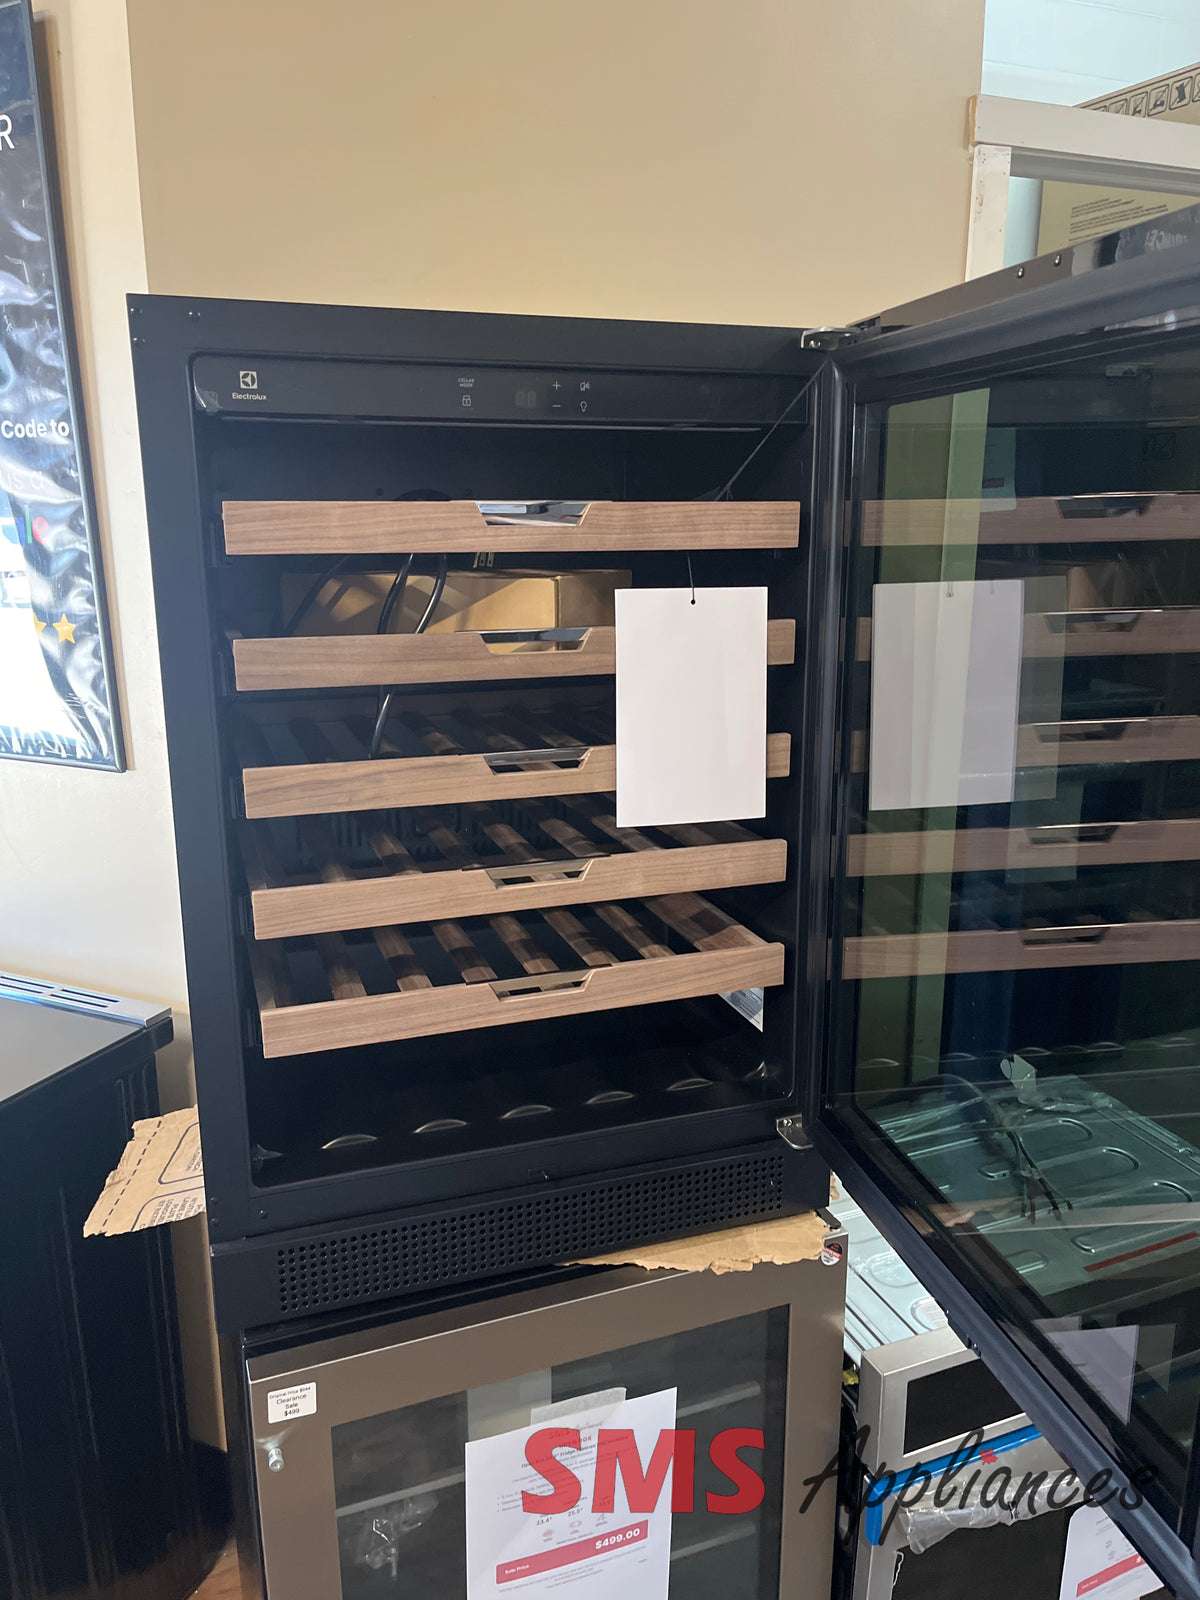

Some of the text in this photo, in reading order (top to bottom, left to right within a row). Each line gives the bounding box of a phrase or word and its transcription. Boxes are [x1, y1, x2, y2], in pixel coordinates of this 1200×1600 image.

[232, 392, 267, 401] Electrolux
[1, 419, 70, 439] Code to
[276, 1394, 307, 1405] Clearance
[284, 1407, 300, 1417] $499
[594, 1527, 641, 1550] $499.00
